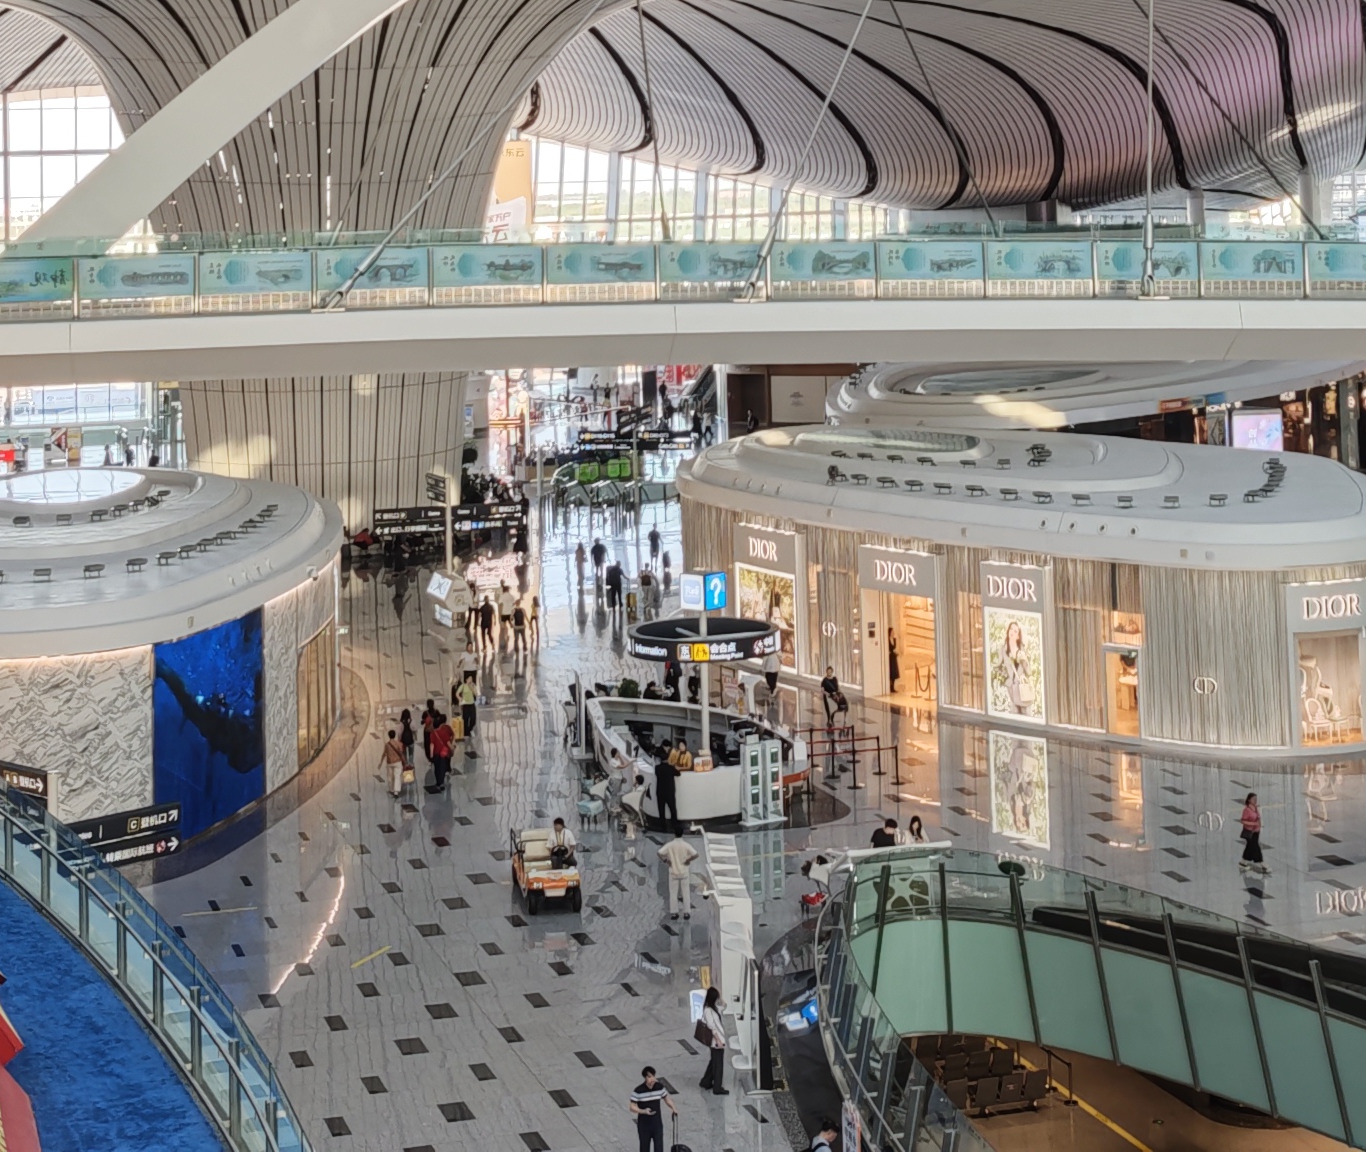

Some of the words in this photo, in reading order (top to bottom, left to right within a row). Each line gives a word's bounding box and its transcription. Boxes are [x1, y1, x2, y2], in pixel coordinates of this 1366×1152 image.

[501, 148, 524, 157] 东云
[748, 536, 778, 562] DIOR
[874, 559, 917, 586] DIOR
[986, 575, 1037, 602] DIOR
[1302, 593, 1362, 620] DIOR
